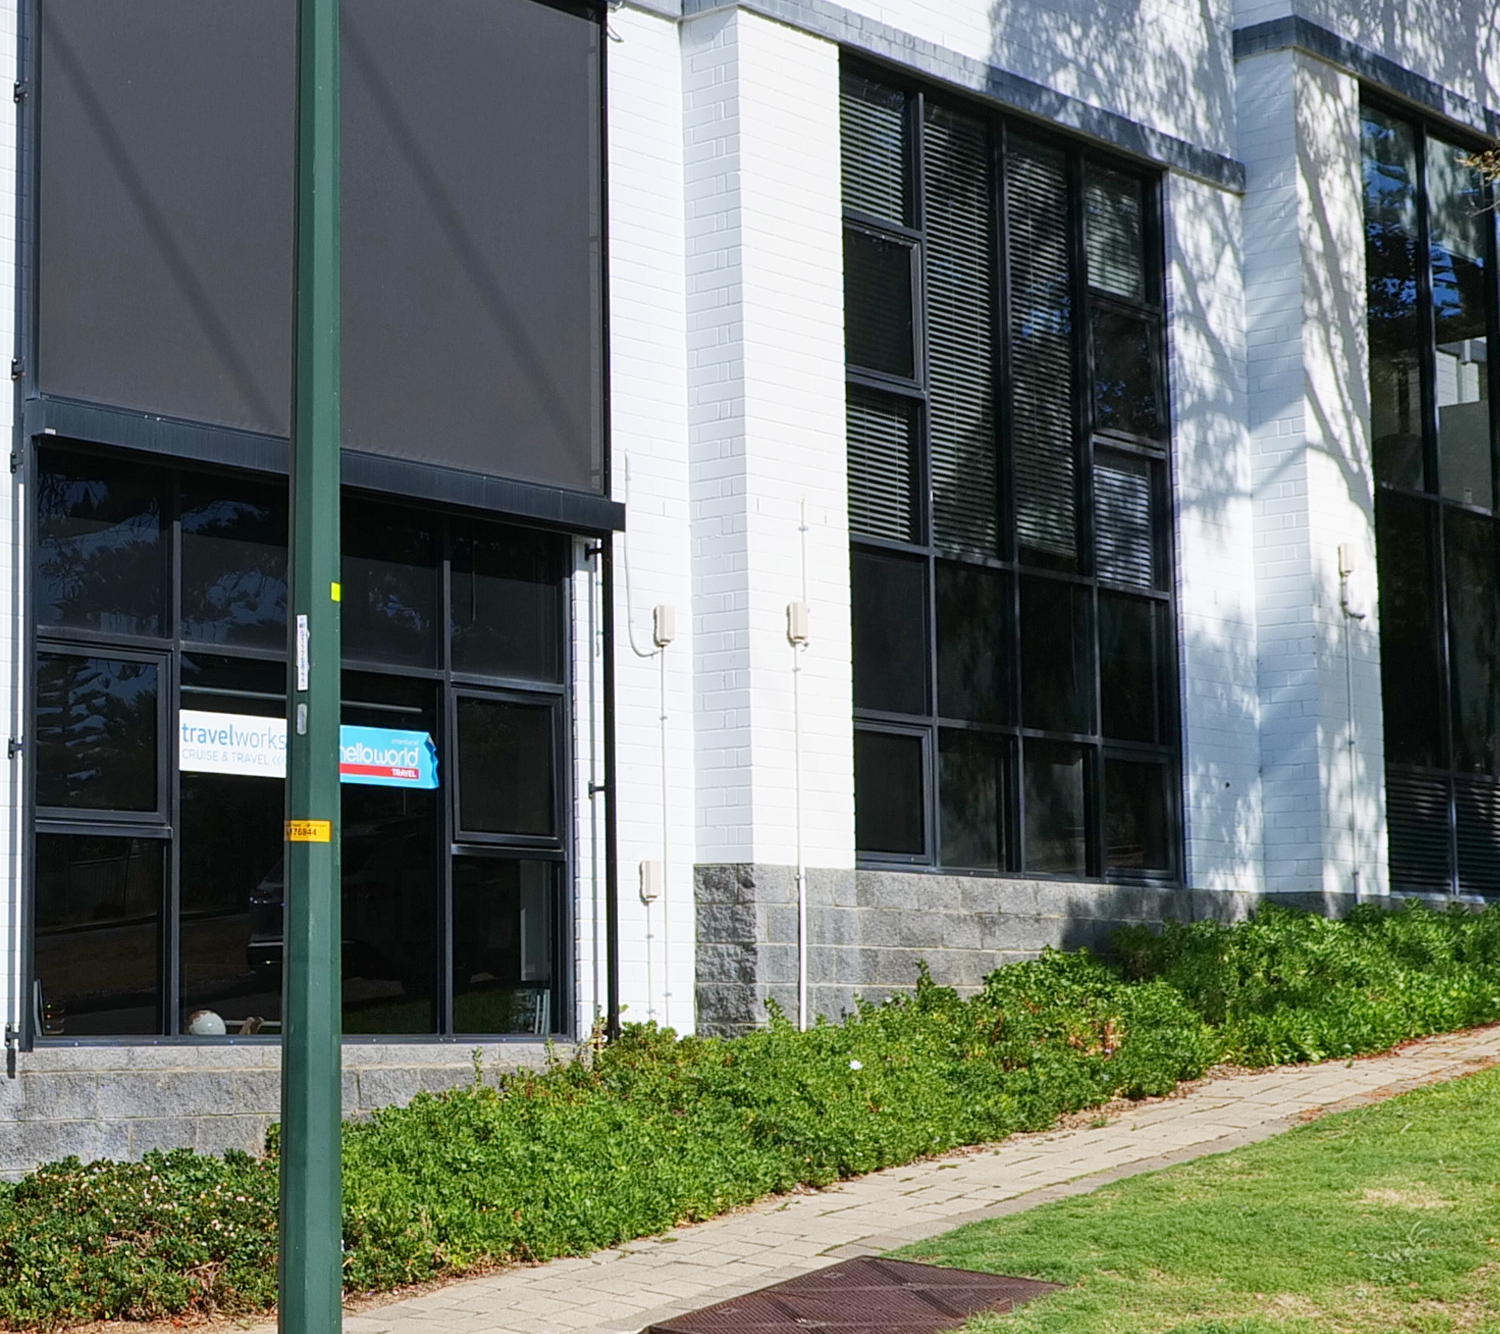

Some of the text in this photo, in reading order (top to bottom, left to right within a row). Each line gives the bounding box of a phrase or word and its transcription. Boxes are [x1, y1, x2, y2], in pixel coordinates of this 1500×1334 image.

[182, 722, 287, 751] travelworks
[181, 748, 219, 762] CRUISE
[231, 752, 269, 766] TRAVEL
[391, 768, 416, 778] TRAVEL
